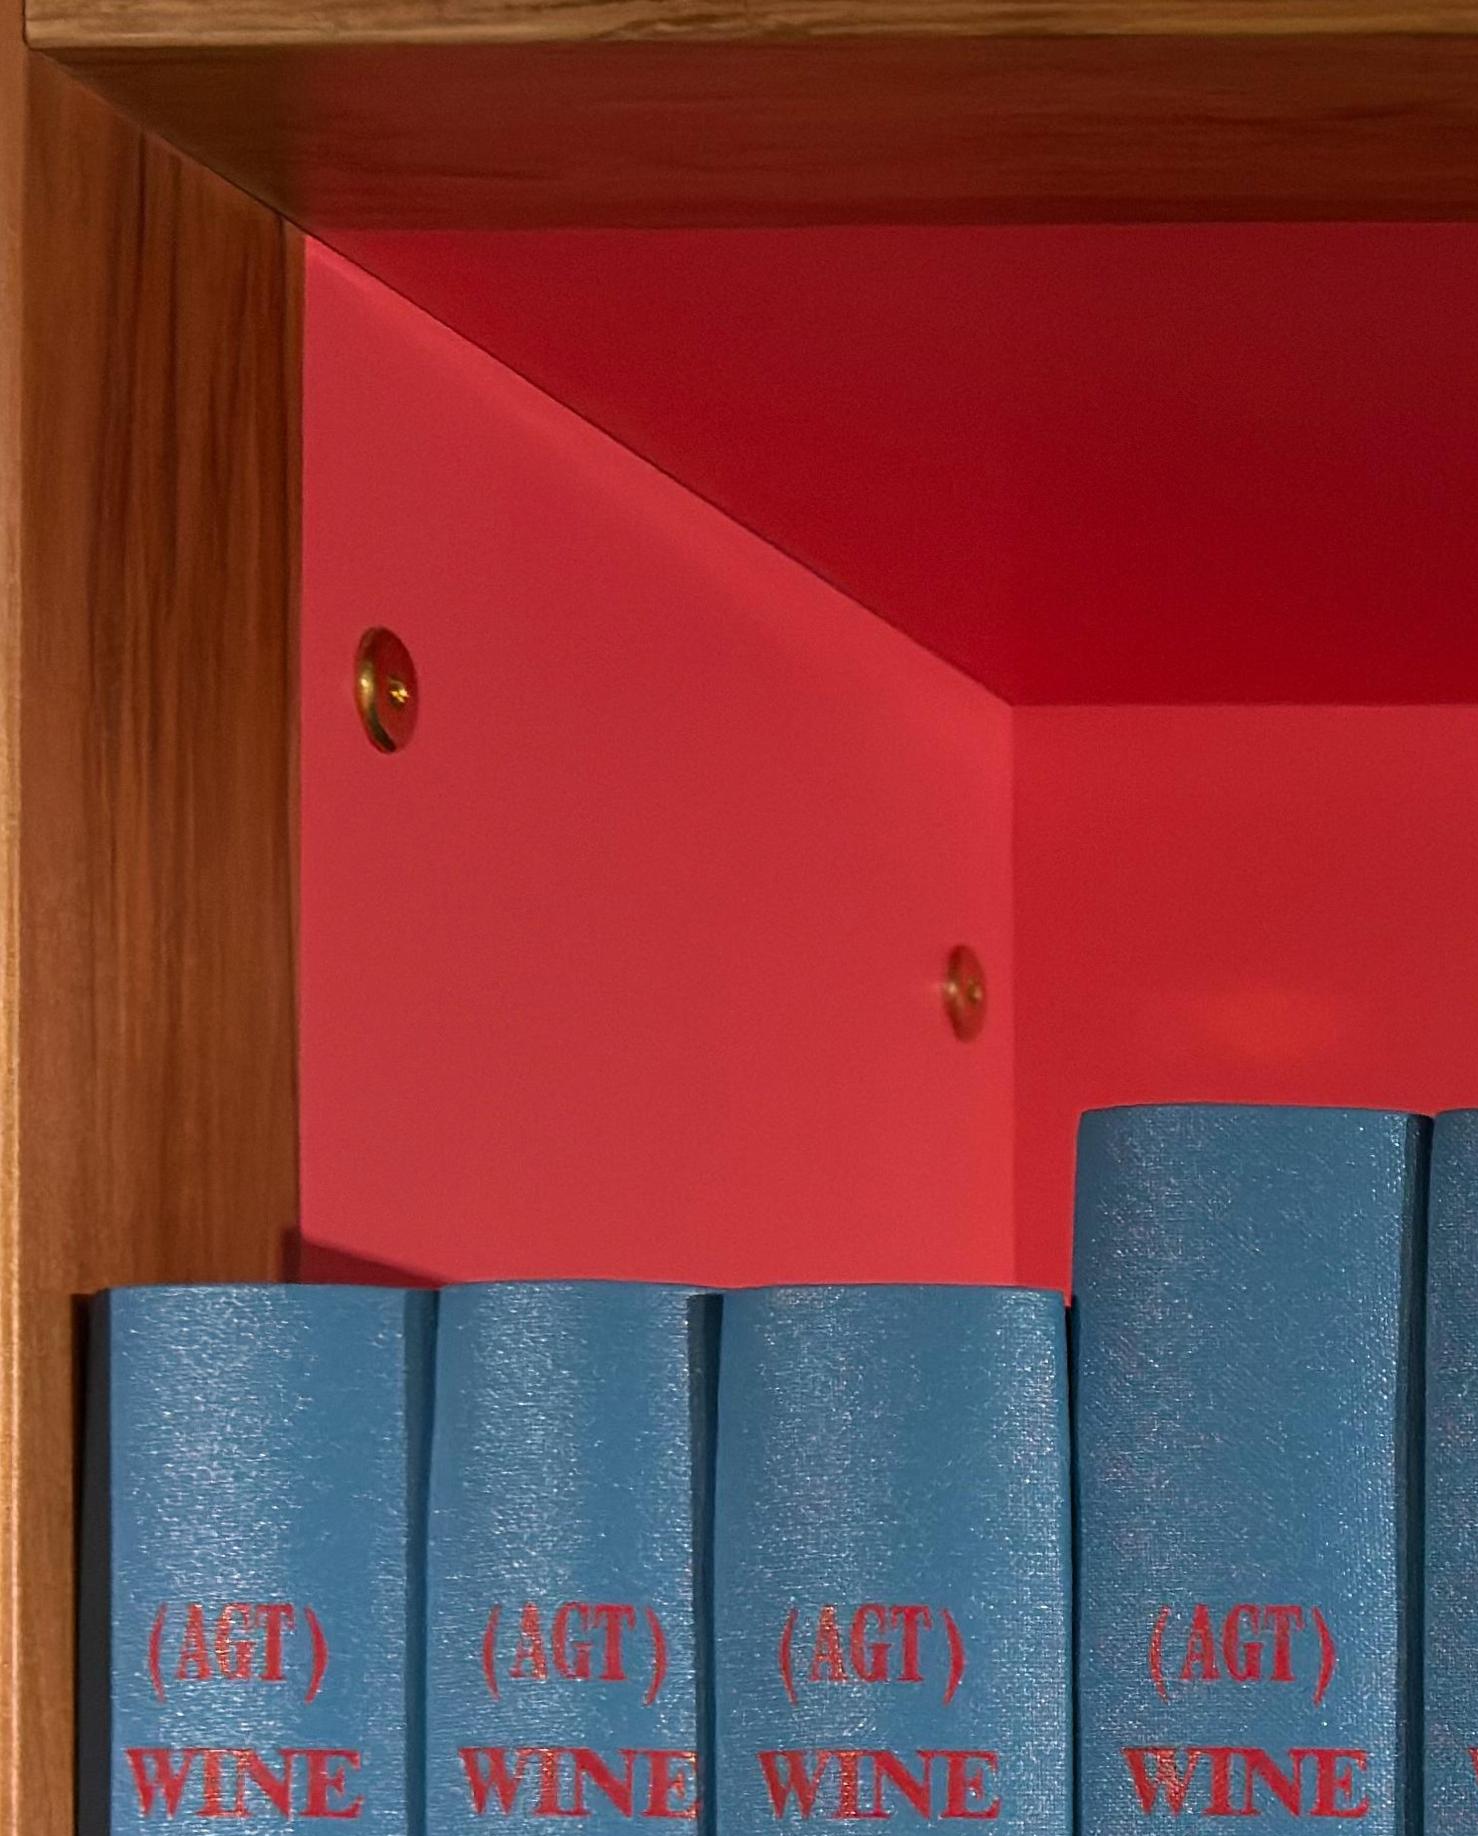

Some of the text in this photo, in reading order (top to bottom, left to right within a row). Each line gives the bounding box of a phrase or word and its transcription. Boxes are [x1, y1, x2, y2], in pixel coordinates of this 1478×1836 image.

[150, 1602, 328, 1703] (AGT)
[482, 1601, 667, 1706] (AGT)
[781, 1604, 966, 1704] (AGT)
[1150, 1604, 1336, 1705] (AGT)
[126, 1747, 363, 1820] WINE
[459, 1747, 701, 1820] WINE
[758, 1750, 1002, 1821] WINE
[1124, 1747, 1370, 1820] WINE
